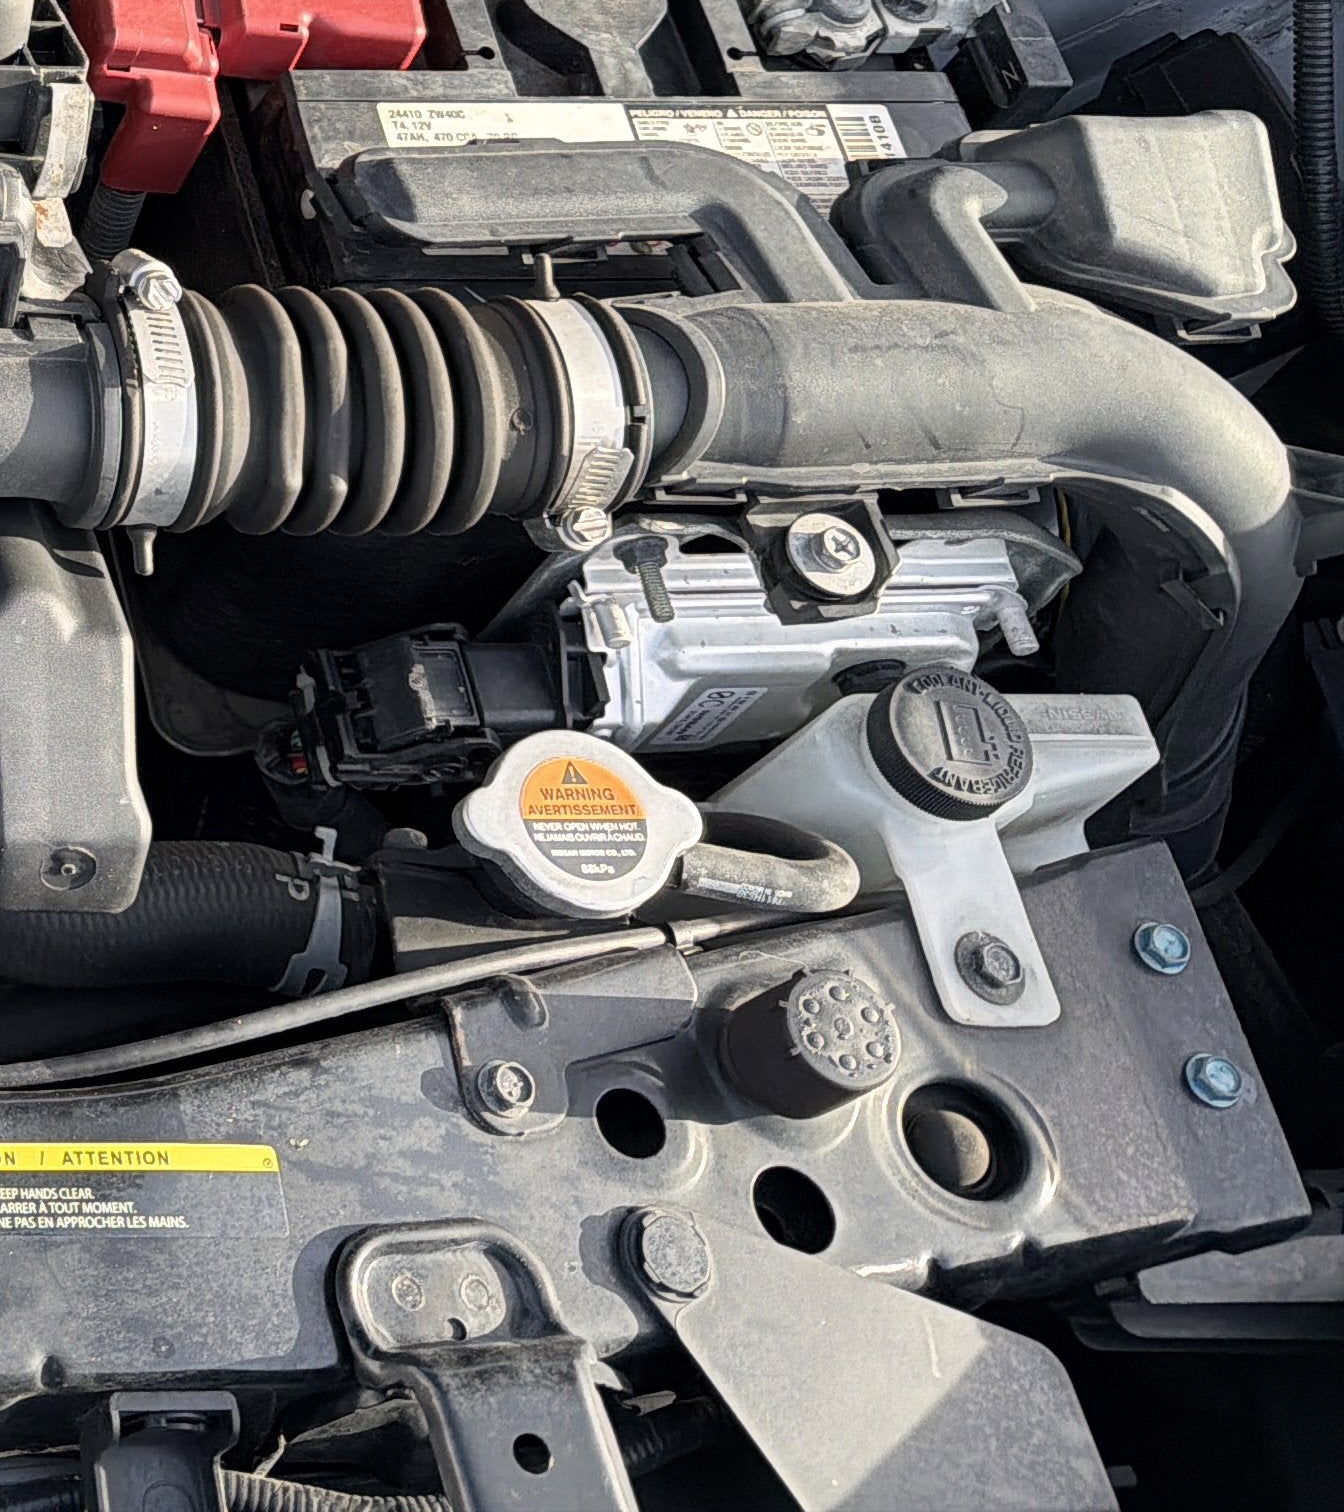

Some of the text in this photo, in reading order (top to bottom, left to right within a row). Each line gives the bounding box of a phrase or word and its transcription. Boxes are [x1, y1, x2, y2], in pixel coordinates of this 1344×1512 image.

[540, 788, 615, 801] WARNING
[528, 804, 636, 816] AVERTISSEMENT
[533, 822, 563, 832] NEVER
[564, 822, 589, 832] OPEN
[590, 822, 618, 832] WHEN
[62, 1151, 170, 1166] ATTENTION
[20, 1188, 58, 1201] HANDS
[59, 1188, 95, 1201] CLEAR.
[39, 1202, 50, 1214] À
[50, 1202, 79, 1214] TOUT
[82, 1202, 138, 1214] MOMENT.
[14, 1216, 36, 1230] PAS
[38, 1216, 54, 1230] EN
[56, 1216, 126, 1230] APPROCHER
[127, 1216, 146, 1230] LES
[148, 1216, 190, 1230] MAINS.
